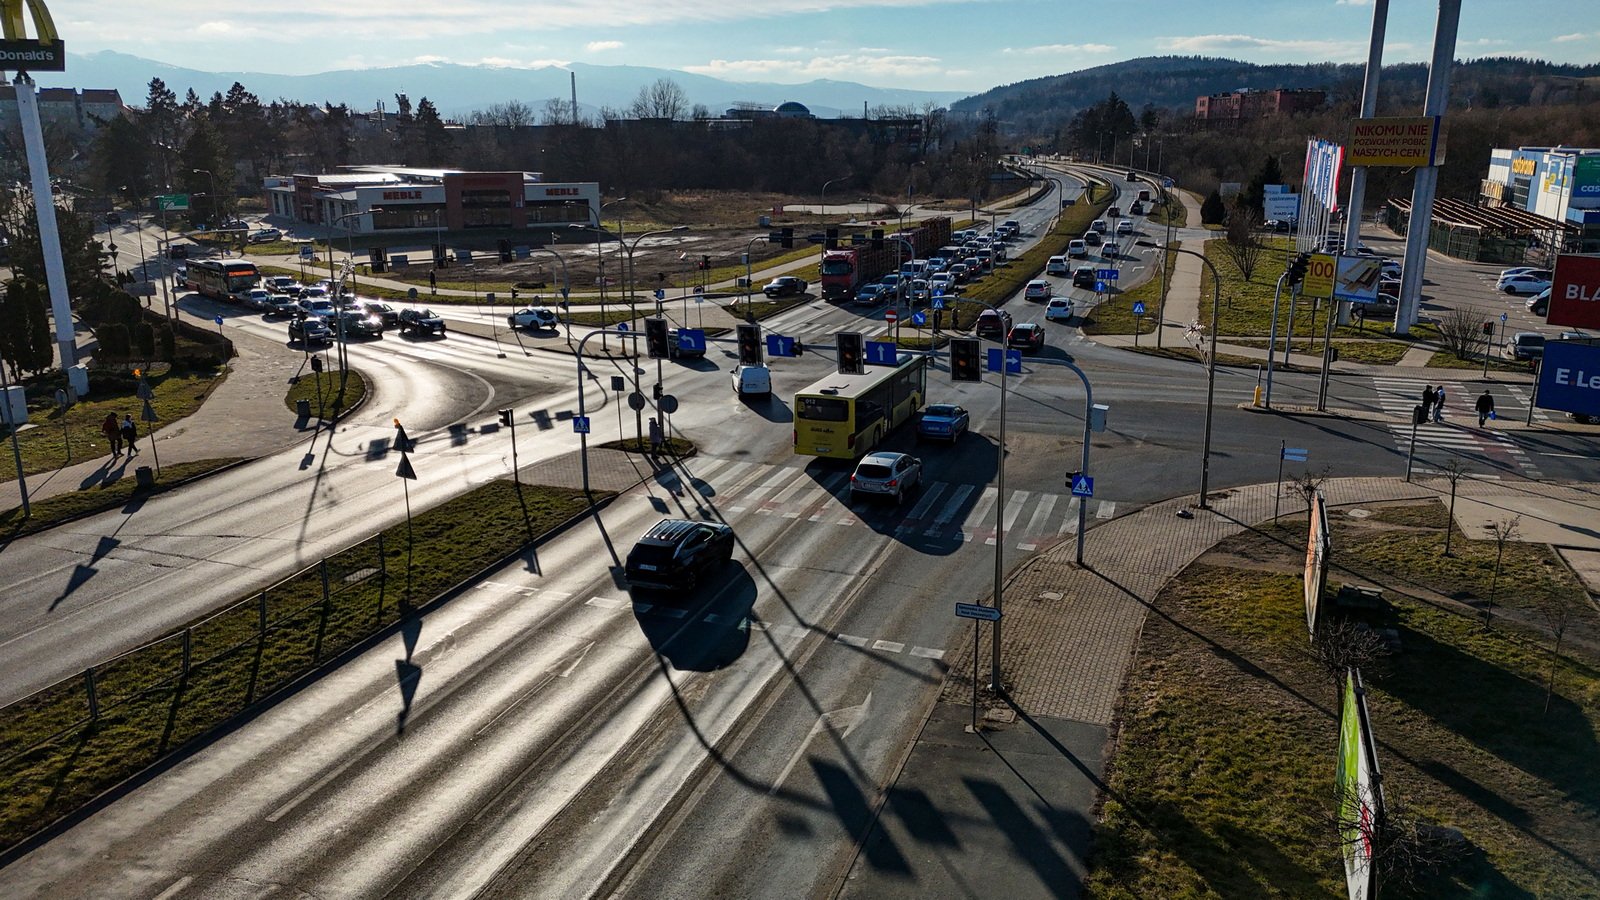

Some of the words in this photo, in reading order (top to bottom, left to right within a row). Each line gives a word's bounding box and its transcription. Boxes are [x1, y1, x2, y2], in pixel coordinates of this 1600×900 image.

[1355, 125, 1404, 136] NIKOMU
[1408, 125, 1428, 136] NIE
[1354, 138, 1400, 146] POZWOLIMY
[1352, 148, 1398, 157] NASZYCH
[383, 191, 422, 200] MEBLE
[546, 188, 579, 196] MEBLE
[1310, 261, 1334, 278] 100
